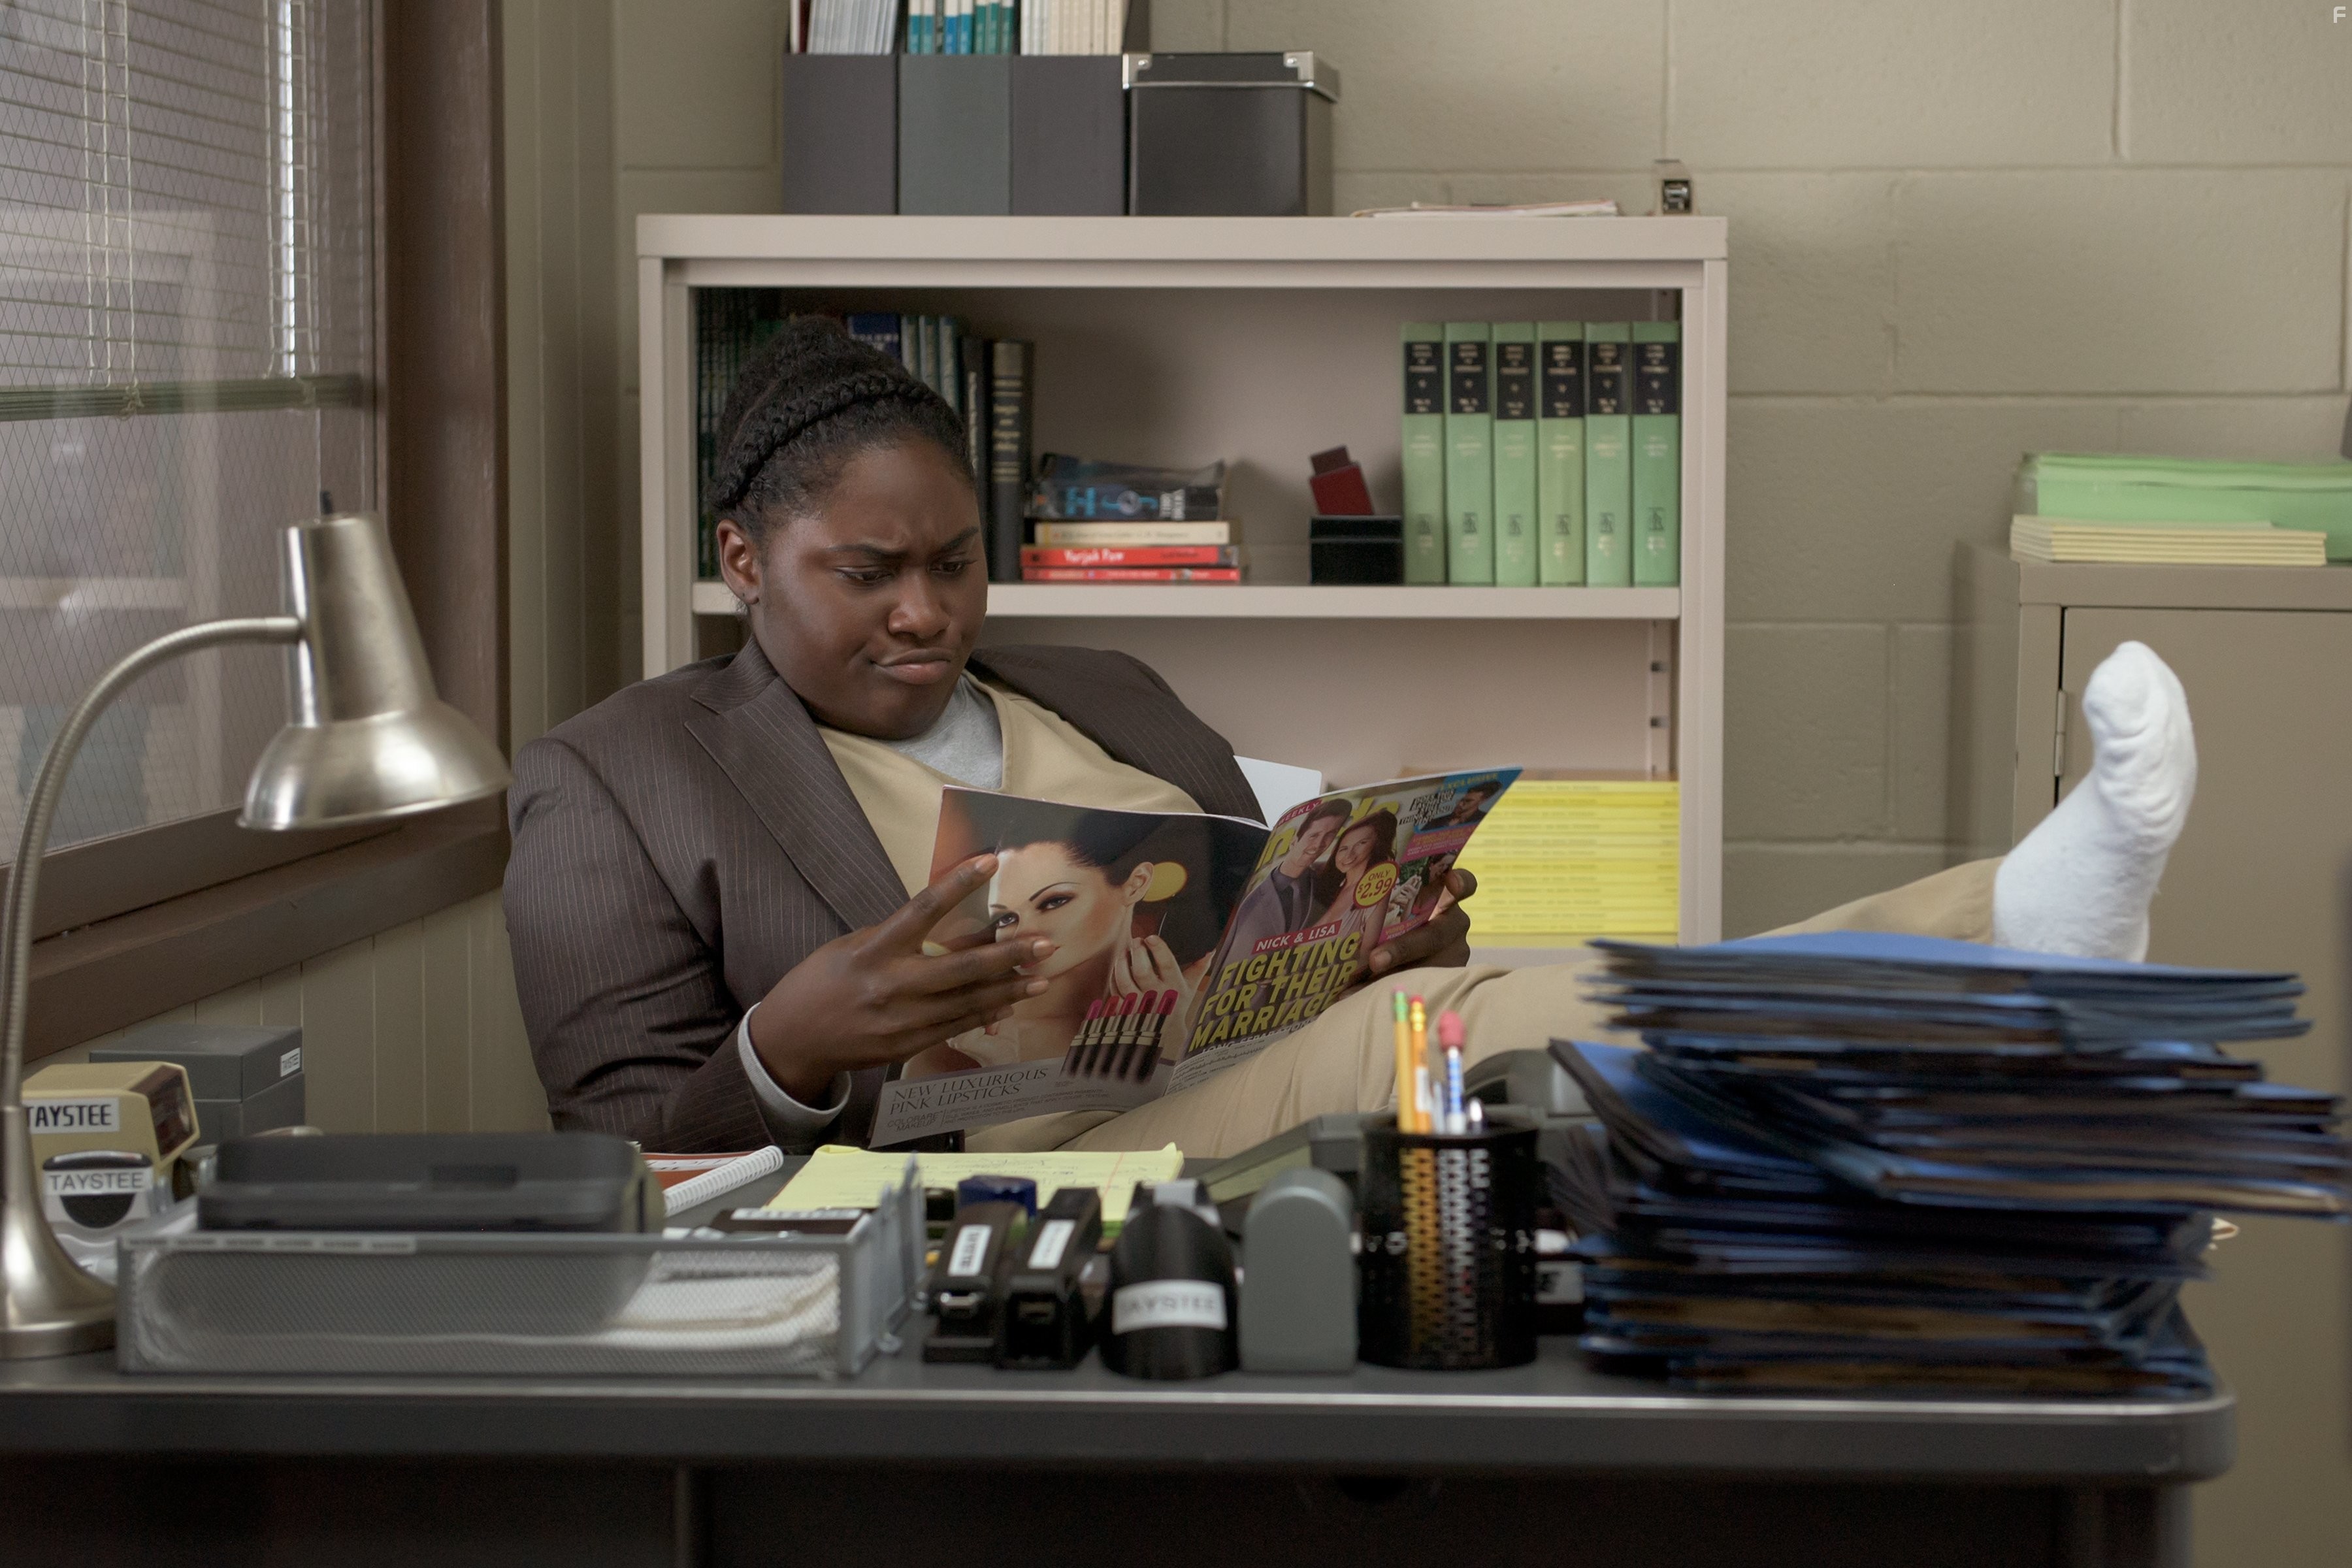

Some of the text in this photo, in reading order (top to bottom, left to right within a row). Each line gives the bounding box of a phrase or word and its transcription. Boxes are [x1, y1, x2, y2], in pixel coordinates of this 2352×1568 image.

[1278, 802, 1319, 826] WEEKLY
[1358, 877, 1392, 900] $2.99
[1368, 870, 1390, 881] ONLY
[1256, 924, 1336, 952] NICK & LISA
[1215, 931, 1361, 993] FIGHTING
[1198, 960, 1358, 1024] FOR THEIR
[1188, 985, 1340, 1053] MARRIAGE
[890, 1083, 1021, 1116] PINK LIPSTICKS
[892, 1068, 1049, 1103] NEW LUXURIOUS
[50, 1171, 144, 1191] TAYSTEE
